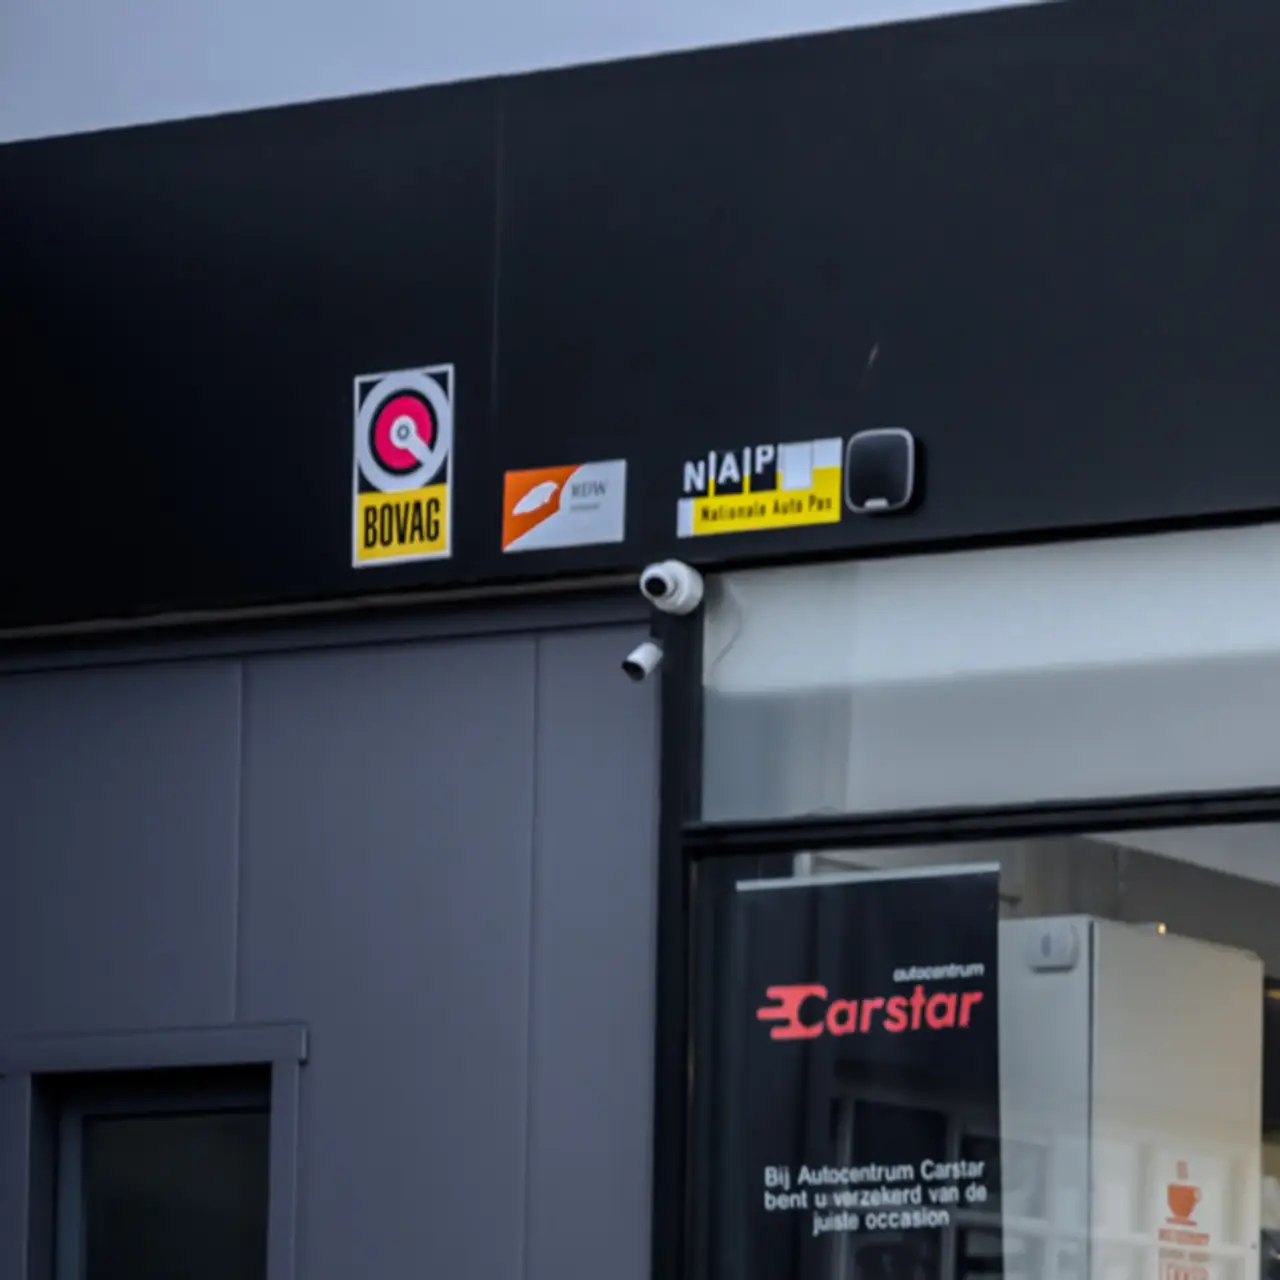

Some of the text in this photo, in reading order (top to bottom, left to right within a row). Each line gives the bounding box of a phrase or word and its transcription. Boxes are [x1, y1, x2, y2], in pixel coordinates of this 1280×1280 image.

[364, 497, 440, 549] BOVAG
[701, 503, 767, 522] Nationale
[772, 497, 804, 515] Auto
[893, 962, 985, 982] autocentrum
[757, 984, 984, 1040] Carstar
[764, 1158, 985, 1191] Bij Autocentrum Carstar
[764, 1182, 988, 1211] bent u verzekerd van de
[812, 1207, 950, 1237] juiste occasion
